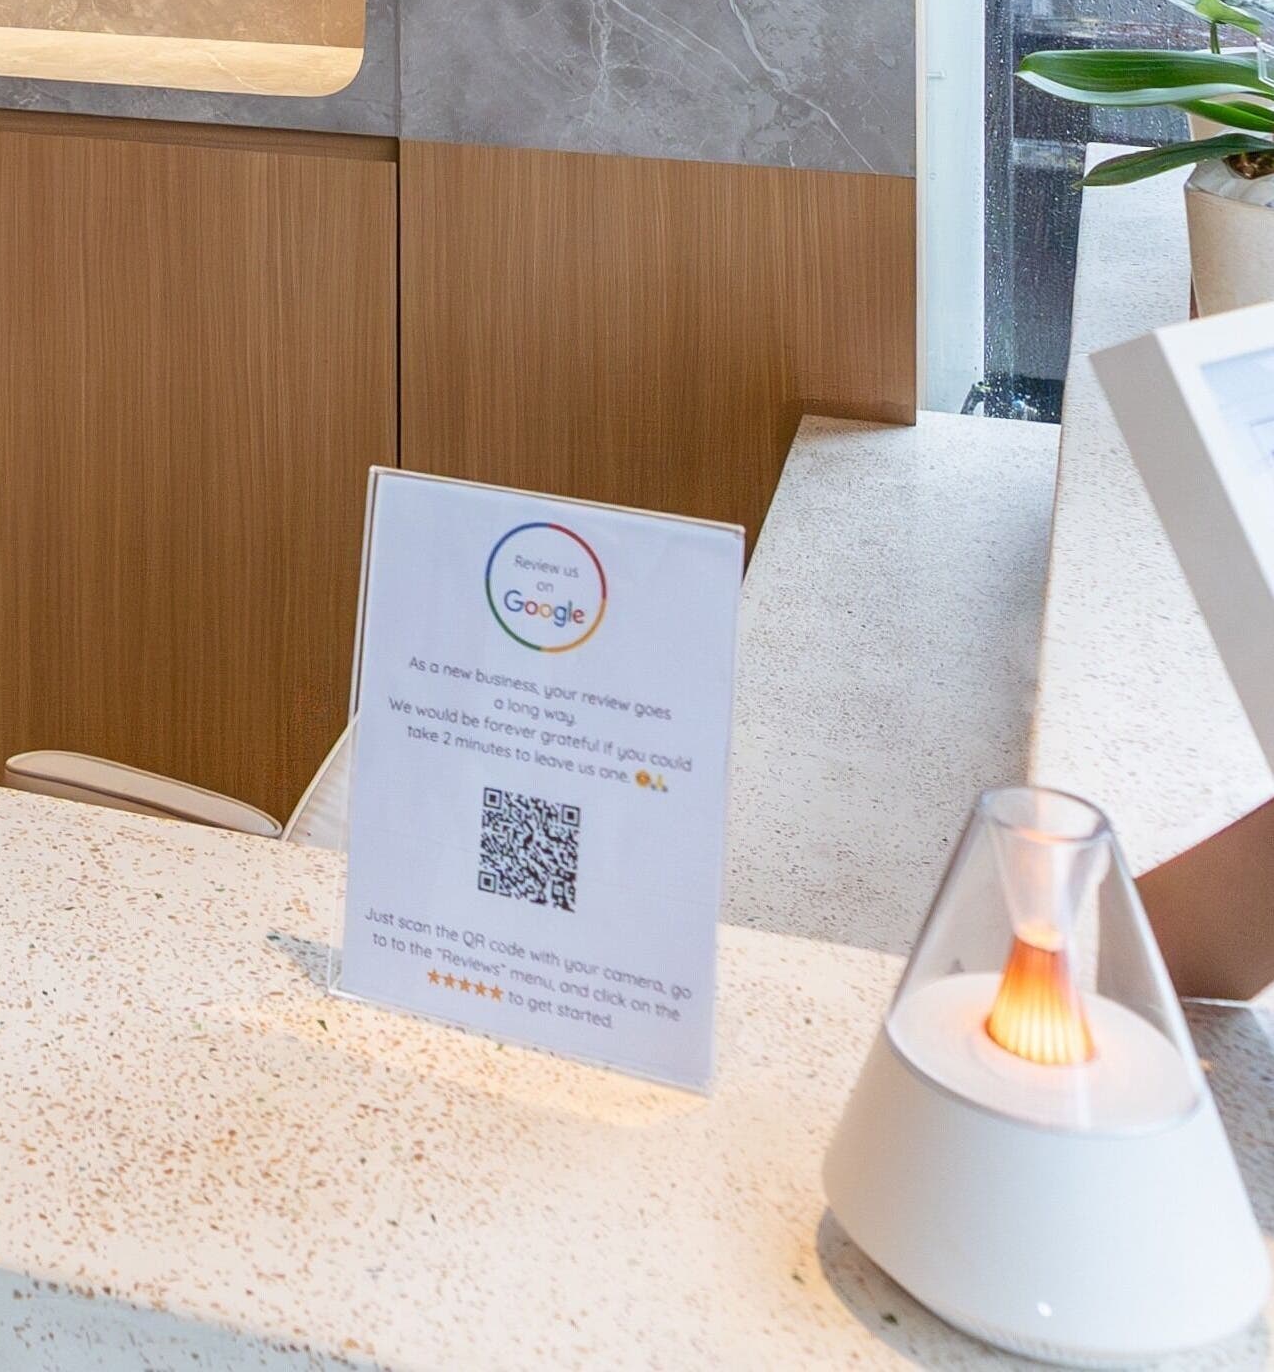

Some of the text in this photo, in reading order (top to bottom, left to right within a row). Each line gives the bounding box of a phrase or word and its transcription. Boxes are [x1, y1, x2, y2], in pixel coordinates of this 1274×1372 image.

[514, 555, 579, 578] Review us
[536, 581, 554, 593] on
[504, 590, 586, 628] Google
[409, 656, 672, 721] As a new business, your review goes
[494, 698, 504, 710] a
[507, 698, 540, 720] long
[388, 696, 692, 772] We would be forever grateful if you could
[407, 725, 439, 742] take
[442, 731, 452, 746] 2
[455, 735, 512, 758] minutes
[515, 748, 531, 762] to
[534, 749, 574, 772] leave
[578, 763, 595, 777] us
[364, 907, 692, 1001] Just scan the QR code with your camera, go
[372, 932, 681, 1022] to to the "Reviews" menu, and click on the
[508, 991, 523, 1006] to
[527, 997, 553, 1013] get
